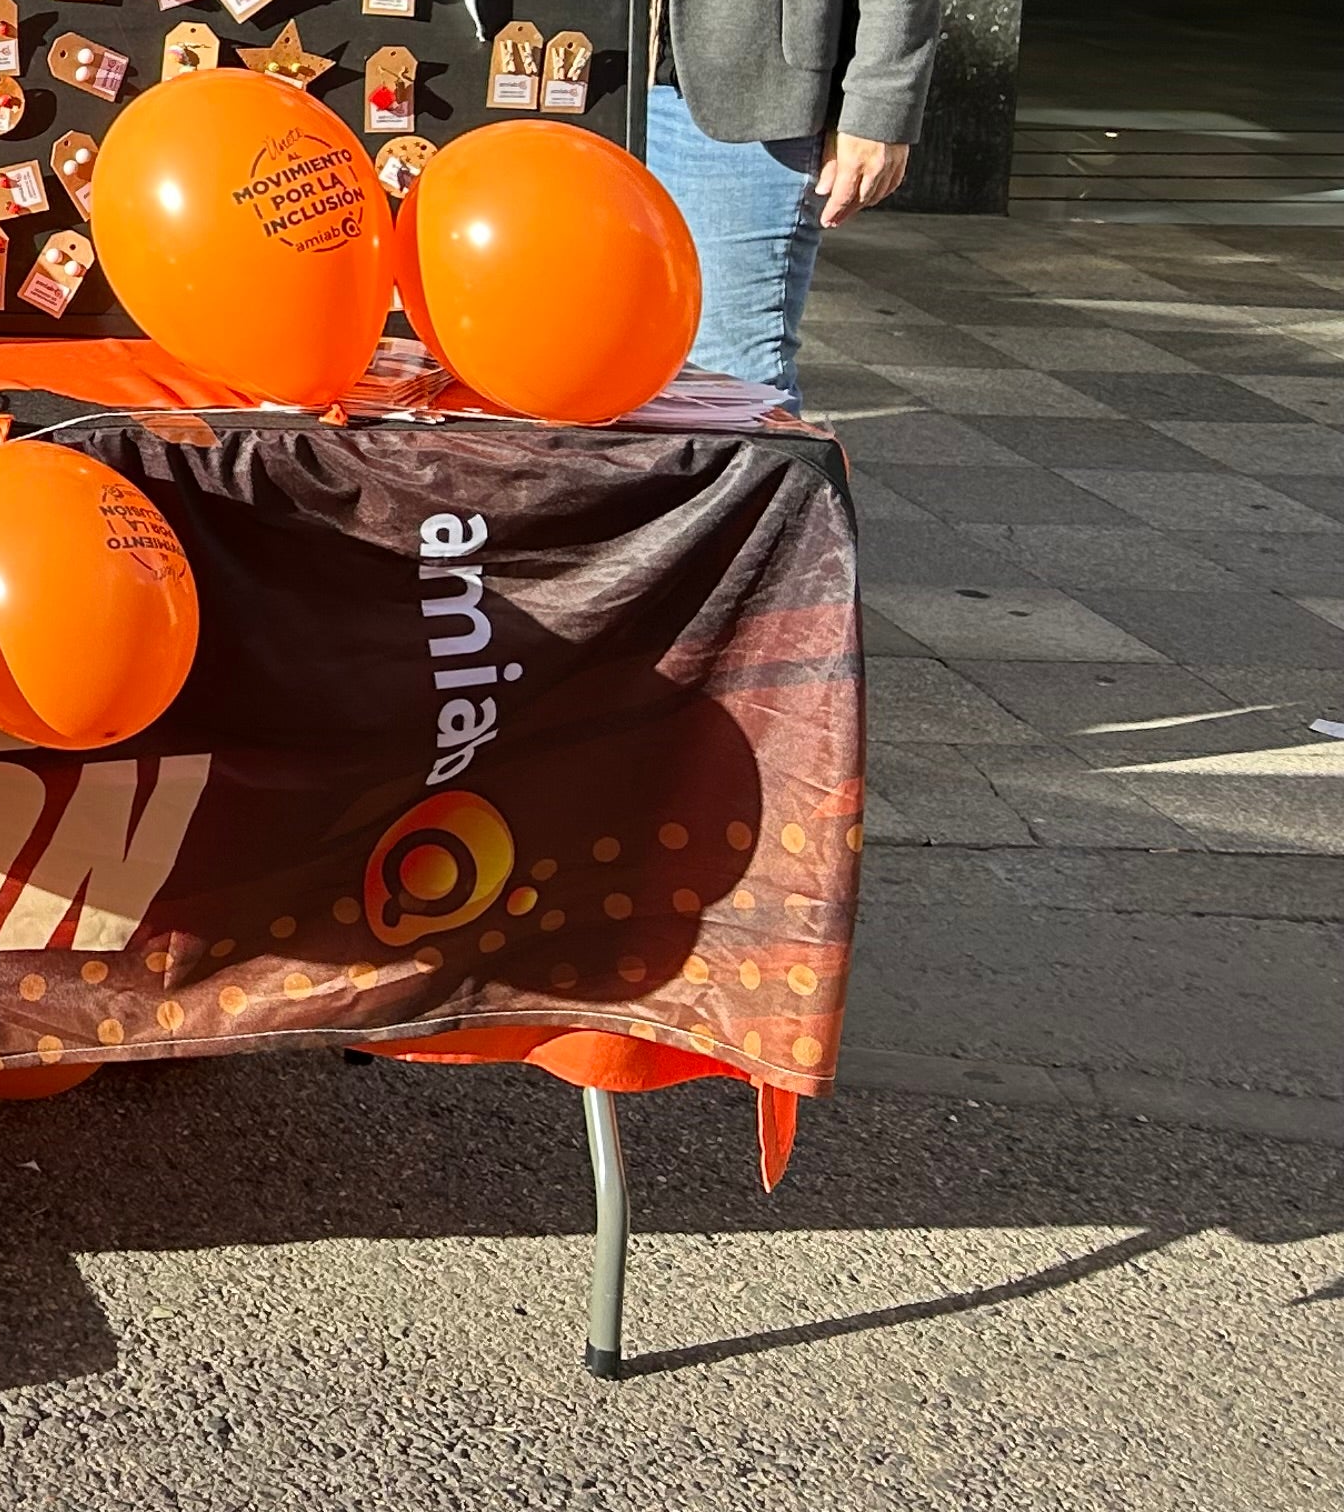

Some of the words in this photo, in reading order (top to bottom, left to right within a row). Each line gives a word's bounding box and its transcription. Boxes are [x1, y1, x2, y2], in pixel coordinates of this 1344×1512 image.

[232, 148, 353, 205] MOVIMIENTO
[287, 151, 303, 162] AL
[263, 186, 365, 238] INCLUSIÓN
[270, 180, 318, 211] POR
[317, 172, 347, 192] LA
[295, 225, 342, 253] amiab
[418, 512, 523, 786] amiab
